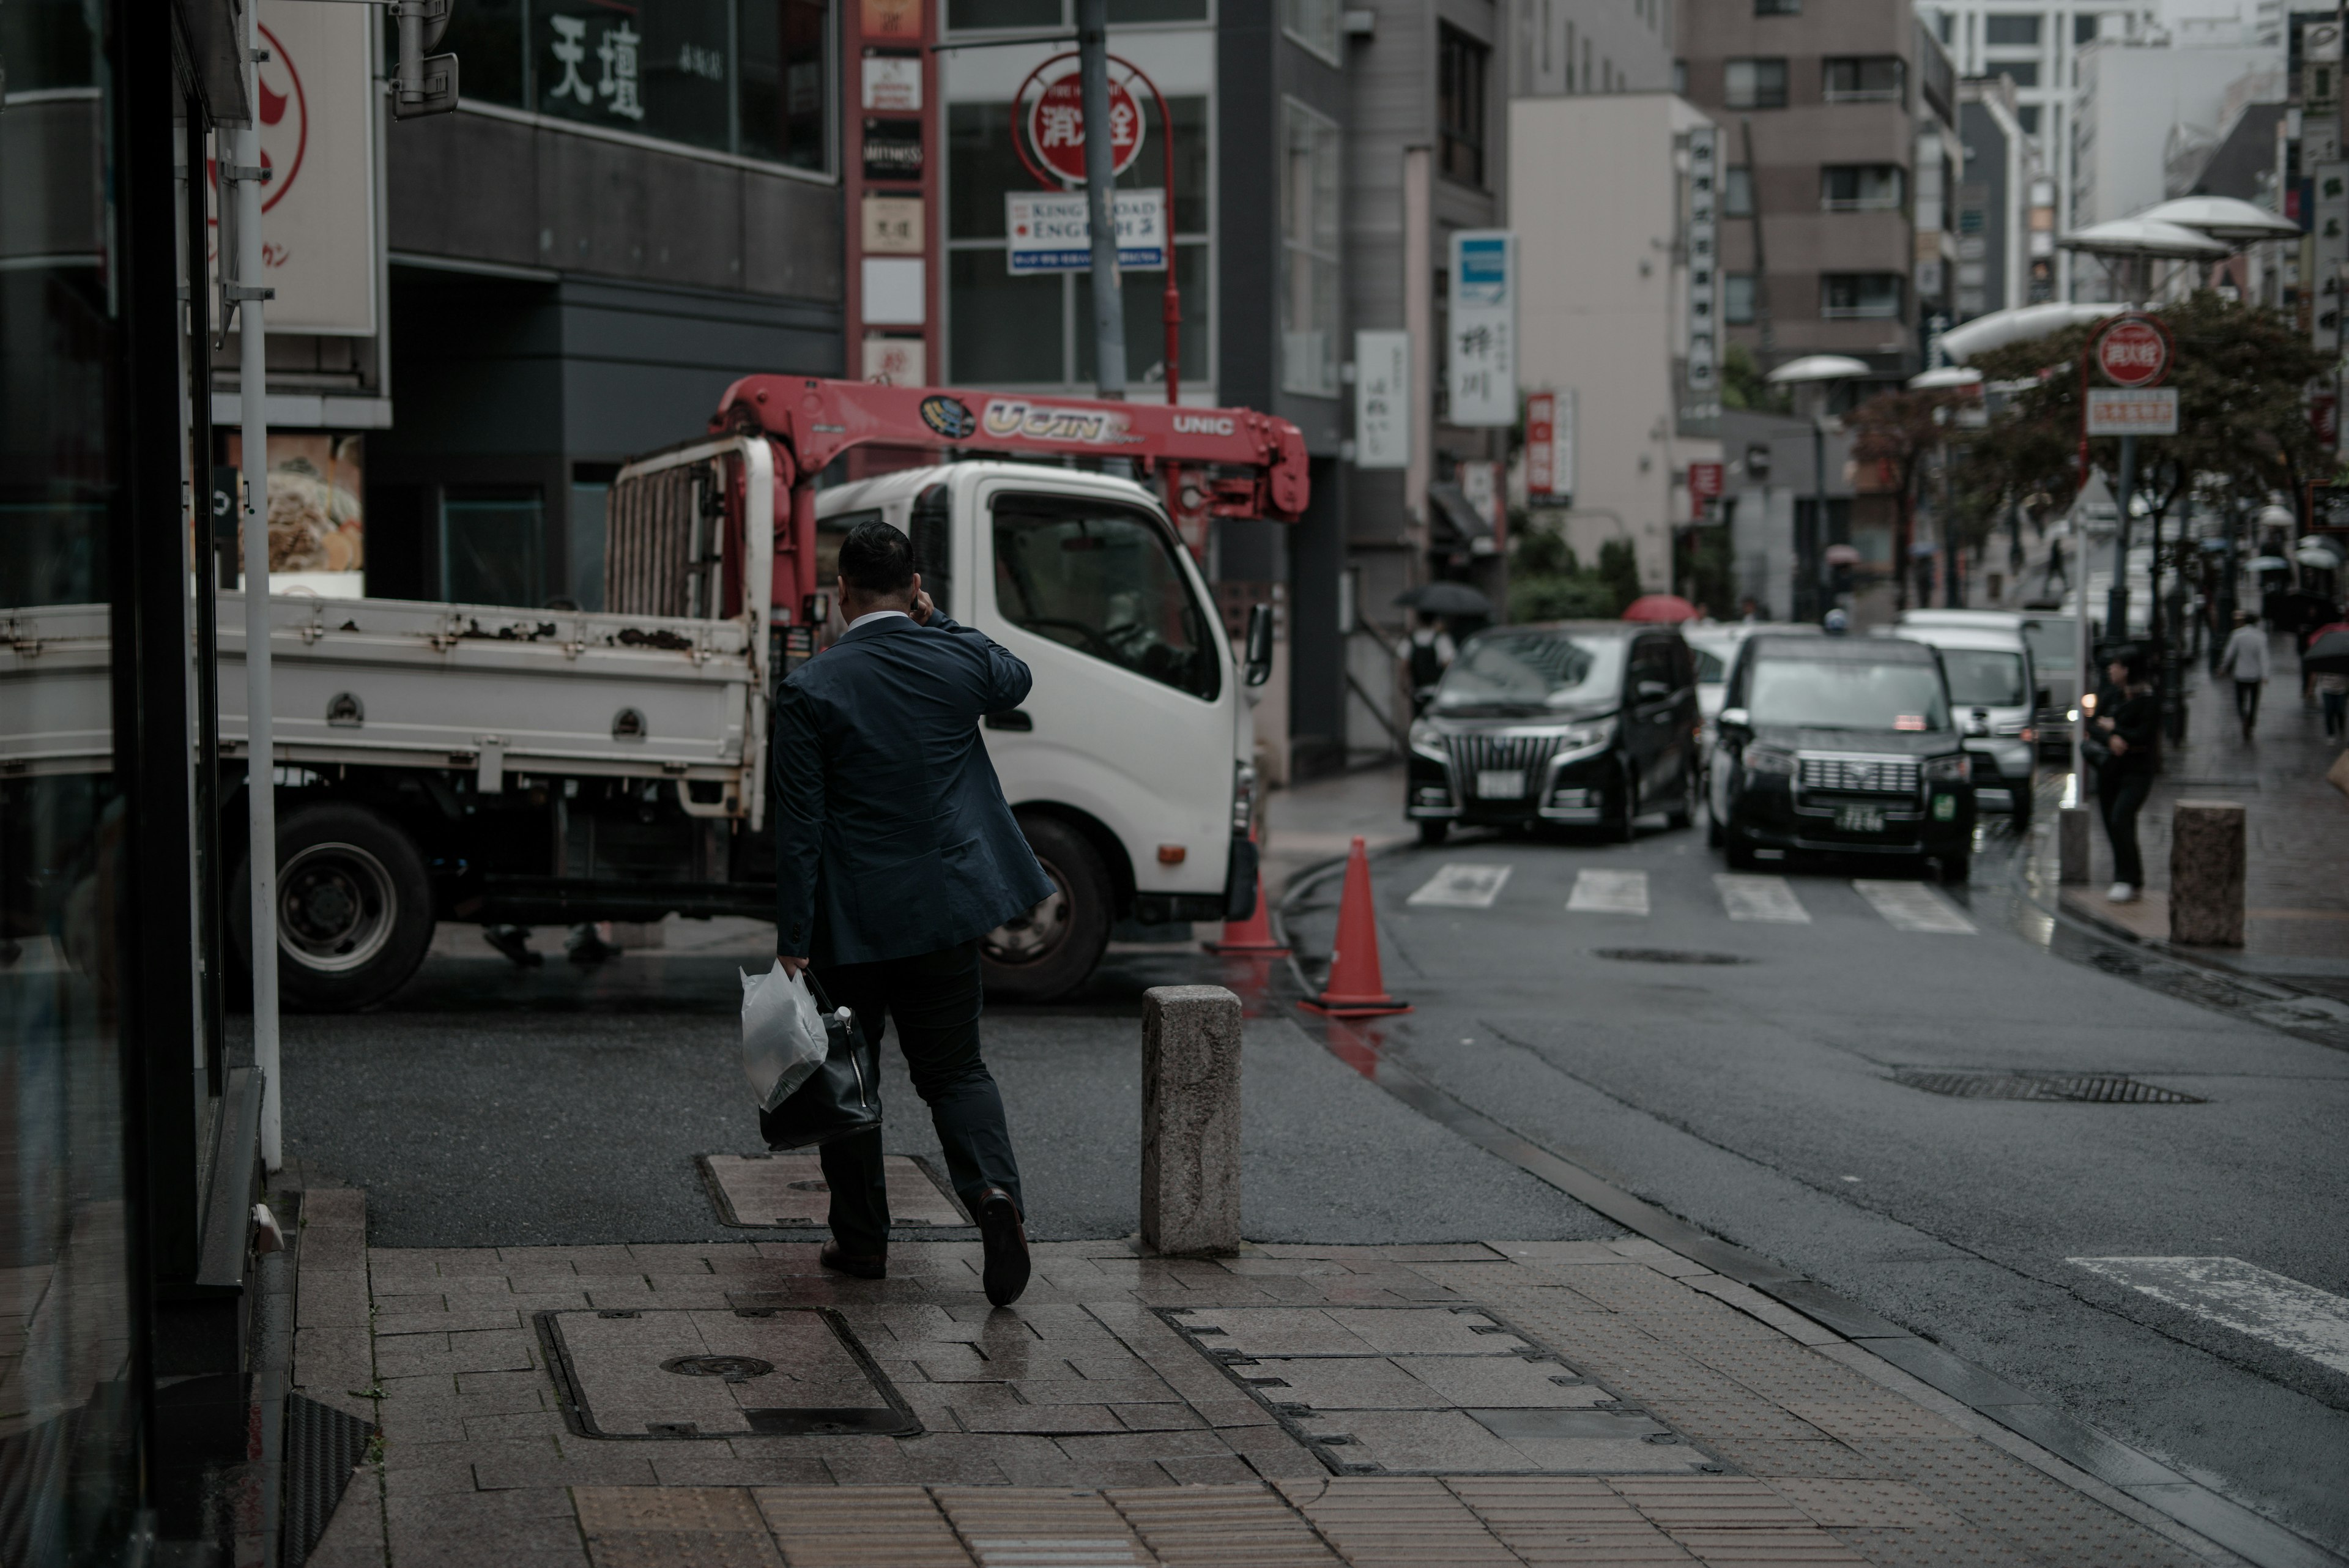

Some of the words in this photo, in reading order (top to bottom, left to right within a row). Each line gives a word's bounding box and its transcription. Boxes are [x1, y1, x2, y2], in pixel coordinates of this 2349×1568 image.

[549, 13, 645, 121] 天壇
[1114, 203, 1156, 216] OAD
[1173, 415, 1234, 436] UNIC
